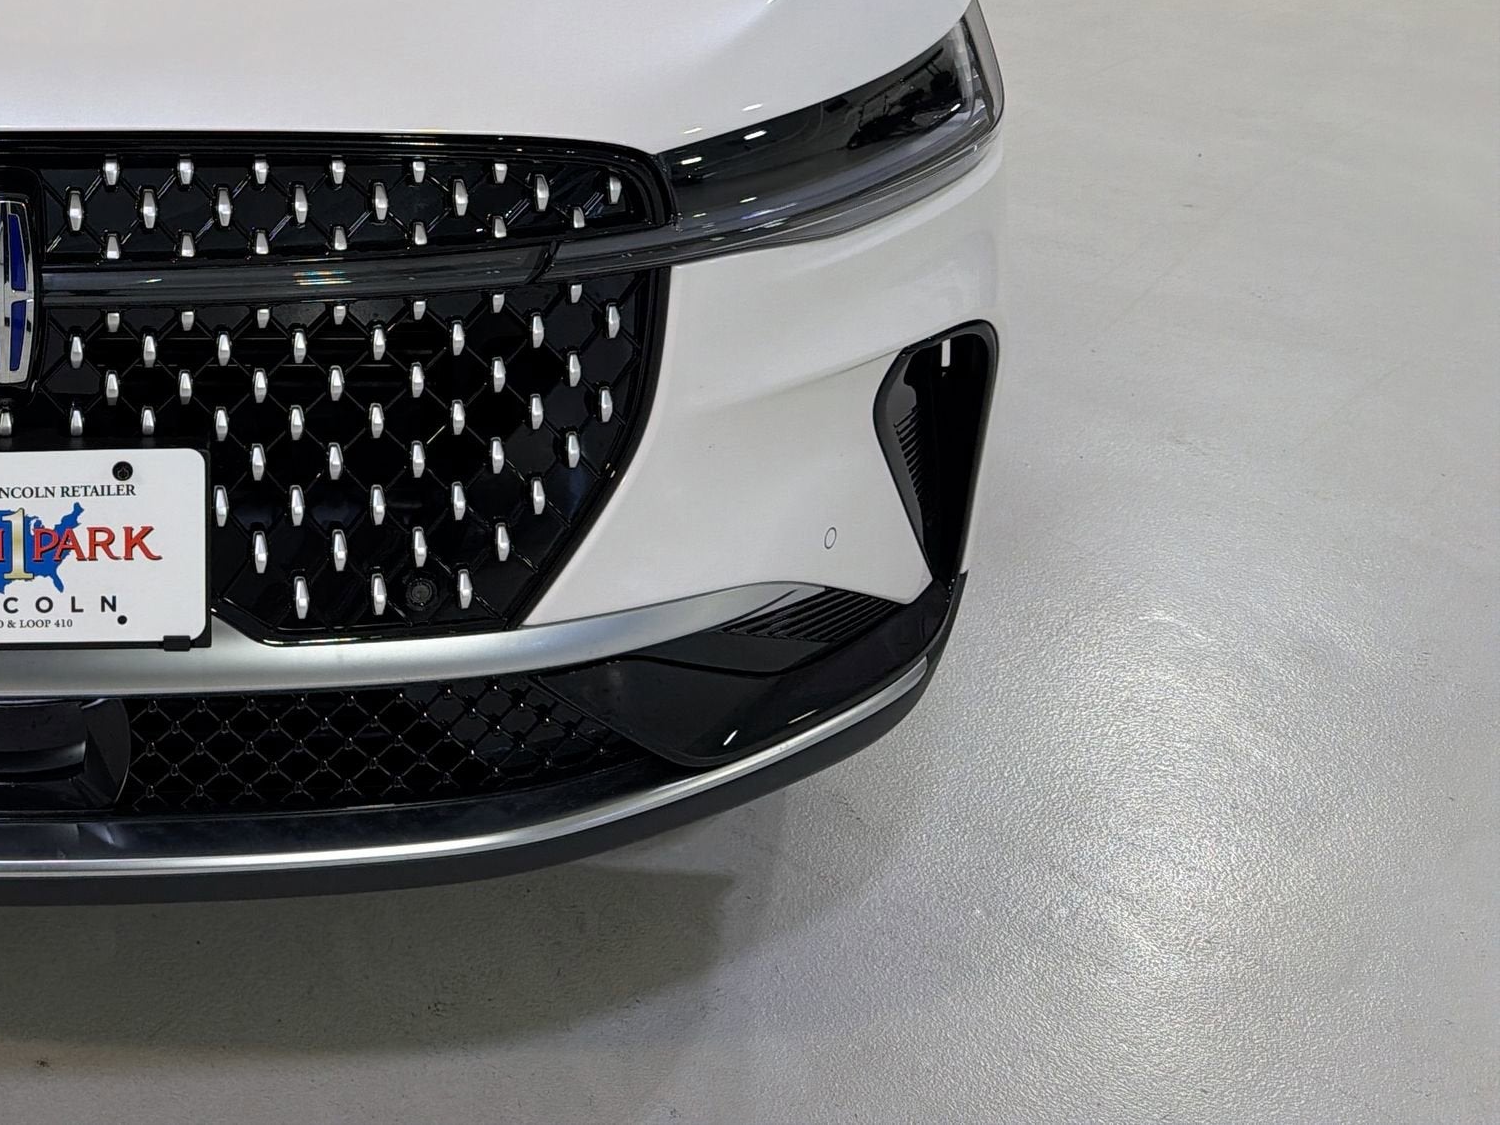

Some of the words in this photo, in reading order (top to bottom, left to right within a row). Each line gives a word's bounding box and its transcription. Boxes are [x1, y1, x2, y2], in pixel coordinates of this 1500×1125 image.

[60, 484, 136, 499] RETAILER
[32, 525, 163, 563] PARK
[7, 619, 16, 630] &
[18, 618, 51, 630] LOOP
[54, 618, 73, 629] 410
